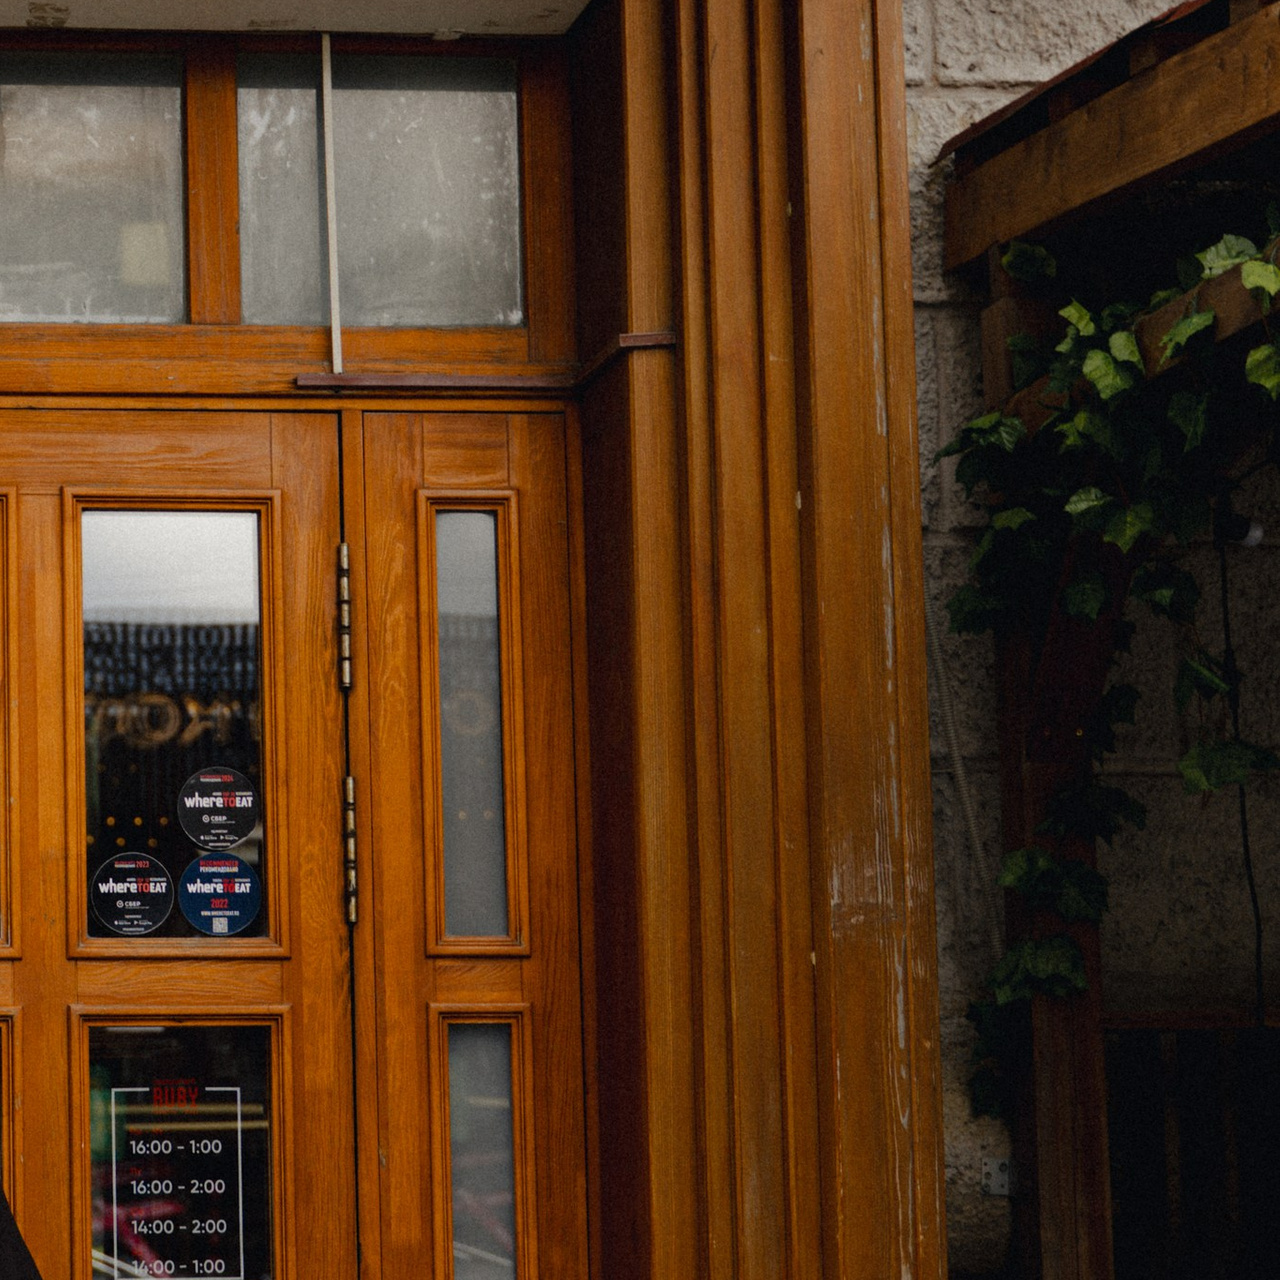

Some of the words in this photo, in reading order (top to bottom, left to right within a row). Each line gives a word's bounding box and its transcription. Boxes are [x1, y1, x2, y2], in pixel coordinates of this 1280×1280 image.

[152, 1086, 198, 1108] RUBY
[130, 1140, 172, 1154] 16:00
[189, 1139, 222, 1154] 1:00
[130, 1180, 173, 1194] 16:00
[190, 1179, 225, 1194] 2:00
[131, 1220, 174, 1234] 14:00
[192, 1219, 227, 1234] 2:00
[132, 1260, 175, 1274] 14:00
[192, 1259, 225, 1274] 1:00
